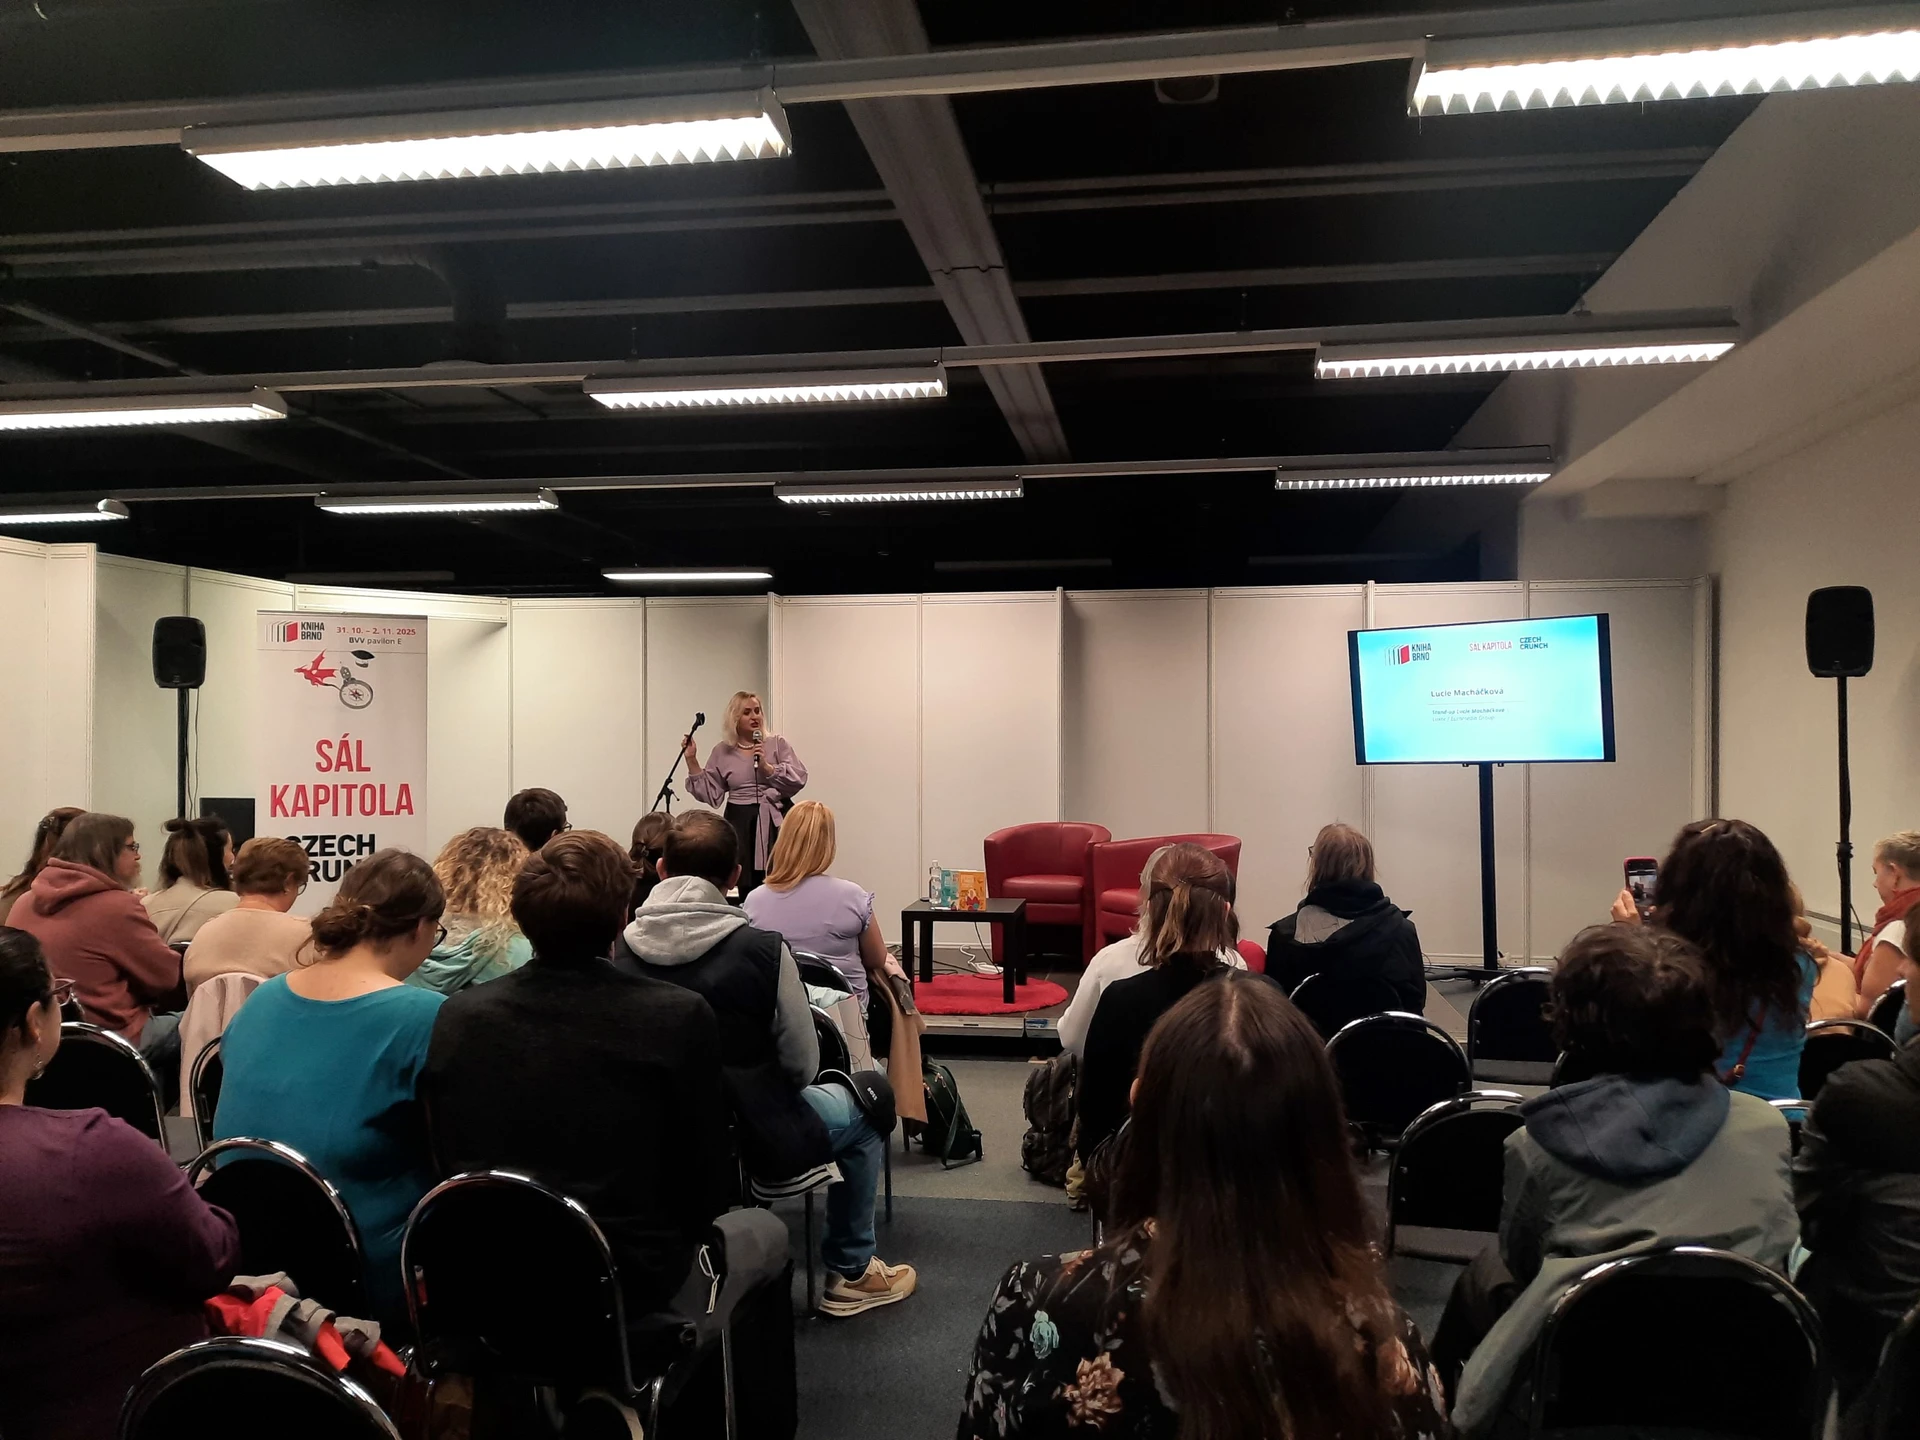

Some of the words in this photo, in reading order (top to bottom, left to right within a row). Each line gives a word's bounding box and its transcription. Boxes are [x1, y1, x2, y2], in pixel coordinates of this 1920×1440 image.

[301, 621, 325, 631] KNIHA
[336, 626, 349, 634] 31.
[396, 628, 416, 636] 2025
[301, 631, 322, 640] BRNO
[367, 638, 395, 646] pavilon
[1482, 641, 1512, 651] KAPITOLA
[1411, 643, 1432, 652] KNIHA
[1412, 652, 1430, 662] BRNO
[1430, 689, 1452, 697] Lucie
[315, 732, 371, 772] SÁL
[270, 783, 414, 818] KAPITOLA
